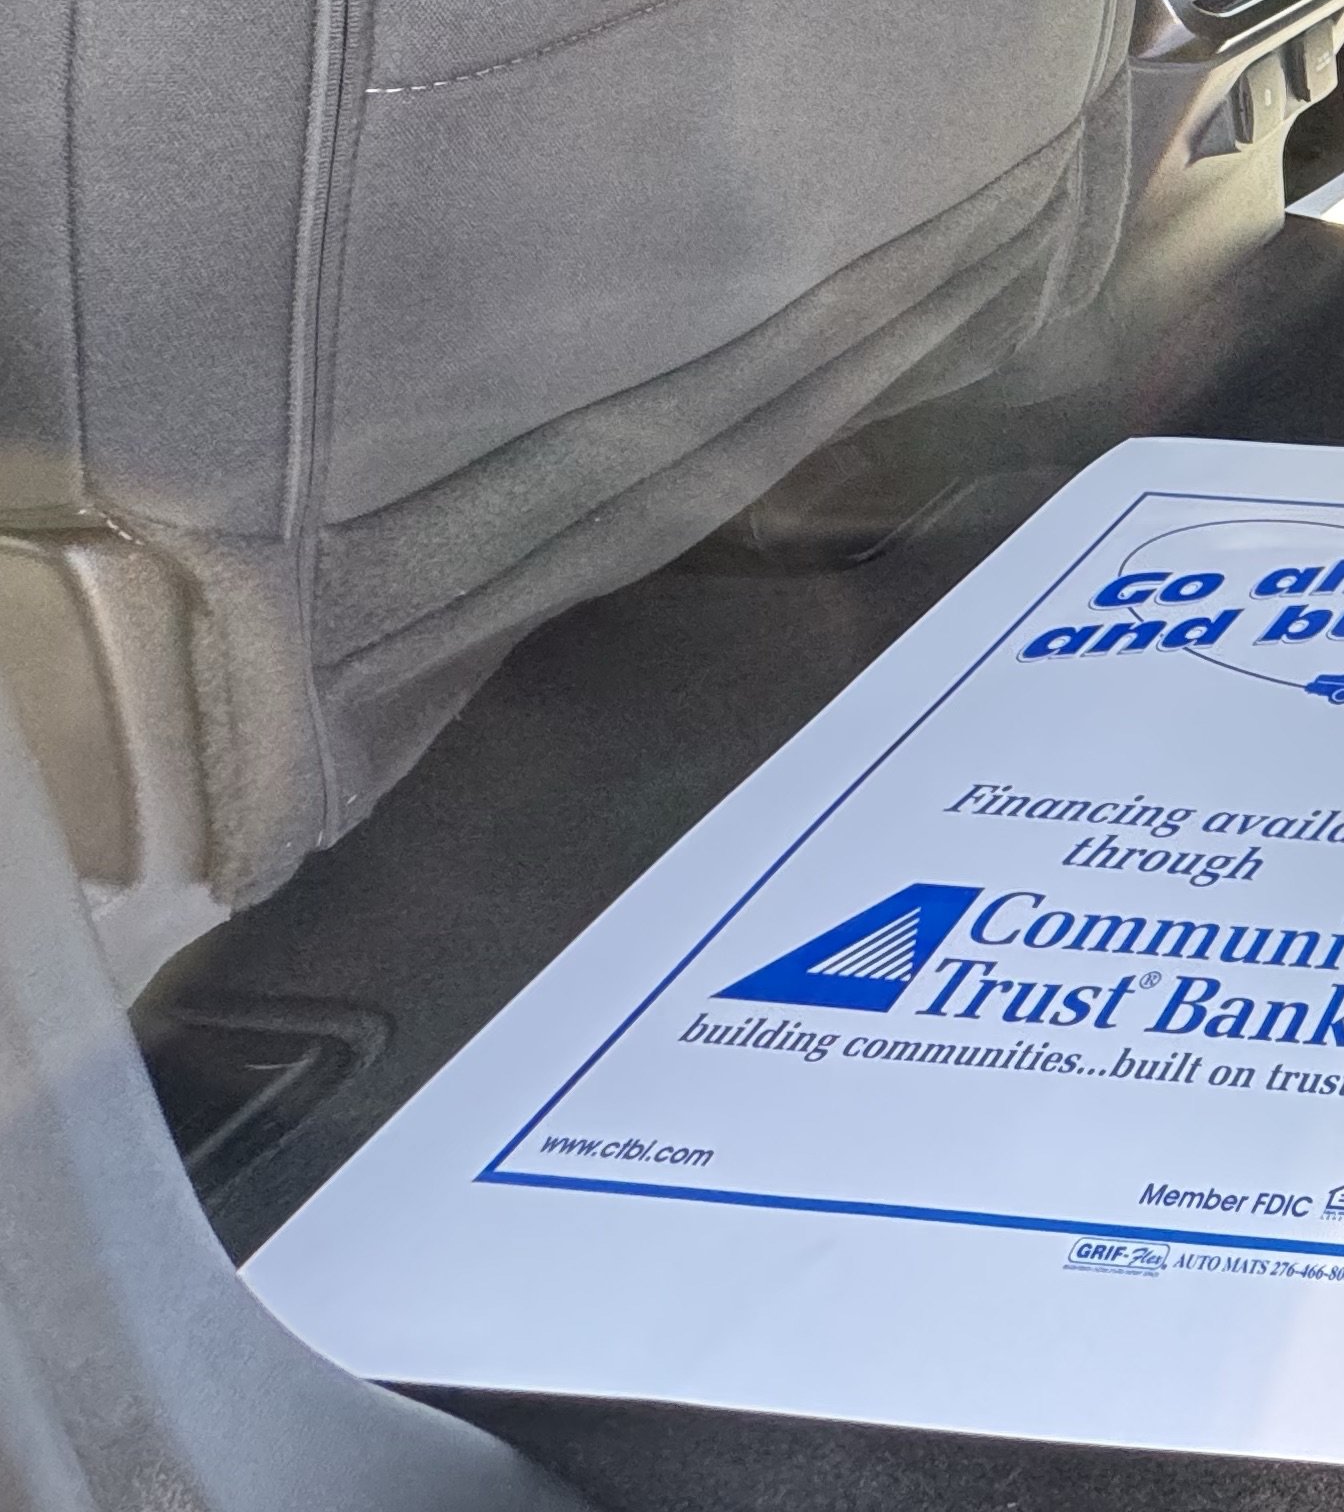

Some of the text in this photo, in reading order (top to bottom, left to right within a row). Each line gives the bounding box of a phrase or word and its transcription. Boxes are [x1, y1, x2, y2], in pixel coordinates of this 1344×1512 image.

[1090, 571, 1225, 611] Go
[1020, 608, 1245, 662] and
[944, 783, 1198, 837] Financing
[1062, 835, 1265, 887] through
[679, 1014, 839, 1063] building
[1208, 1062, 1254, 1089] on
[1138, 1182, 1313, 1217] Member FDIC
[1173, 1253, 1221, 1271] AUTO
[1222, 1256, 1270, 1275] MATS
